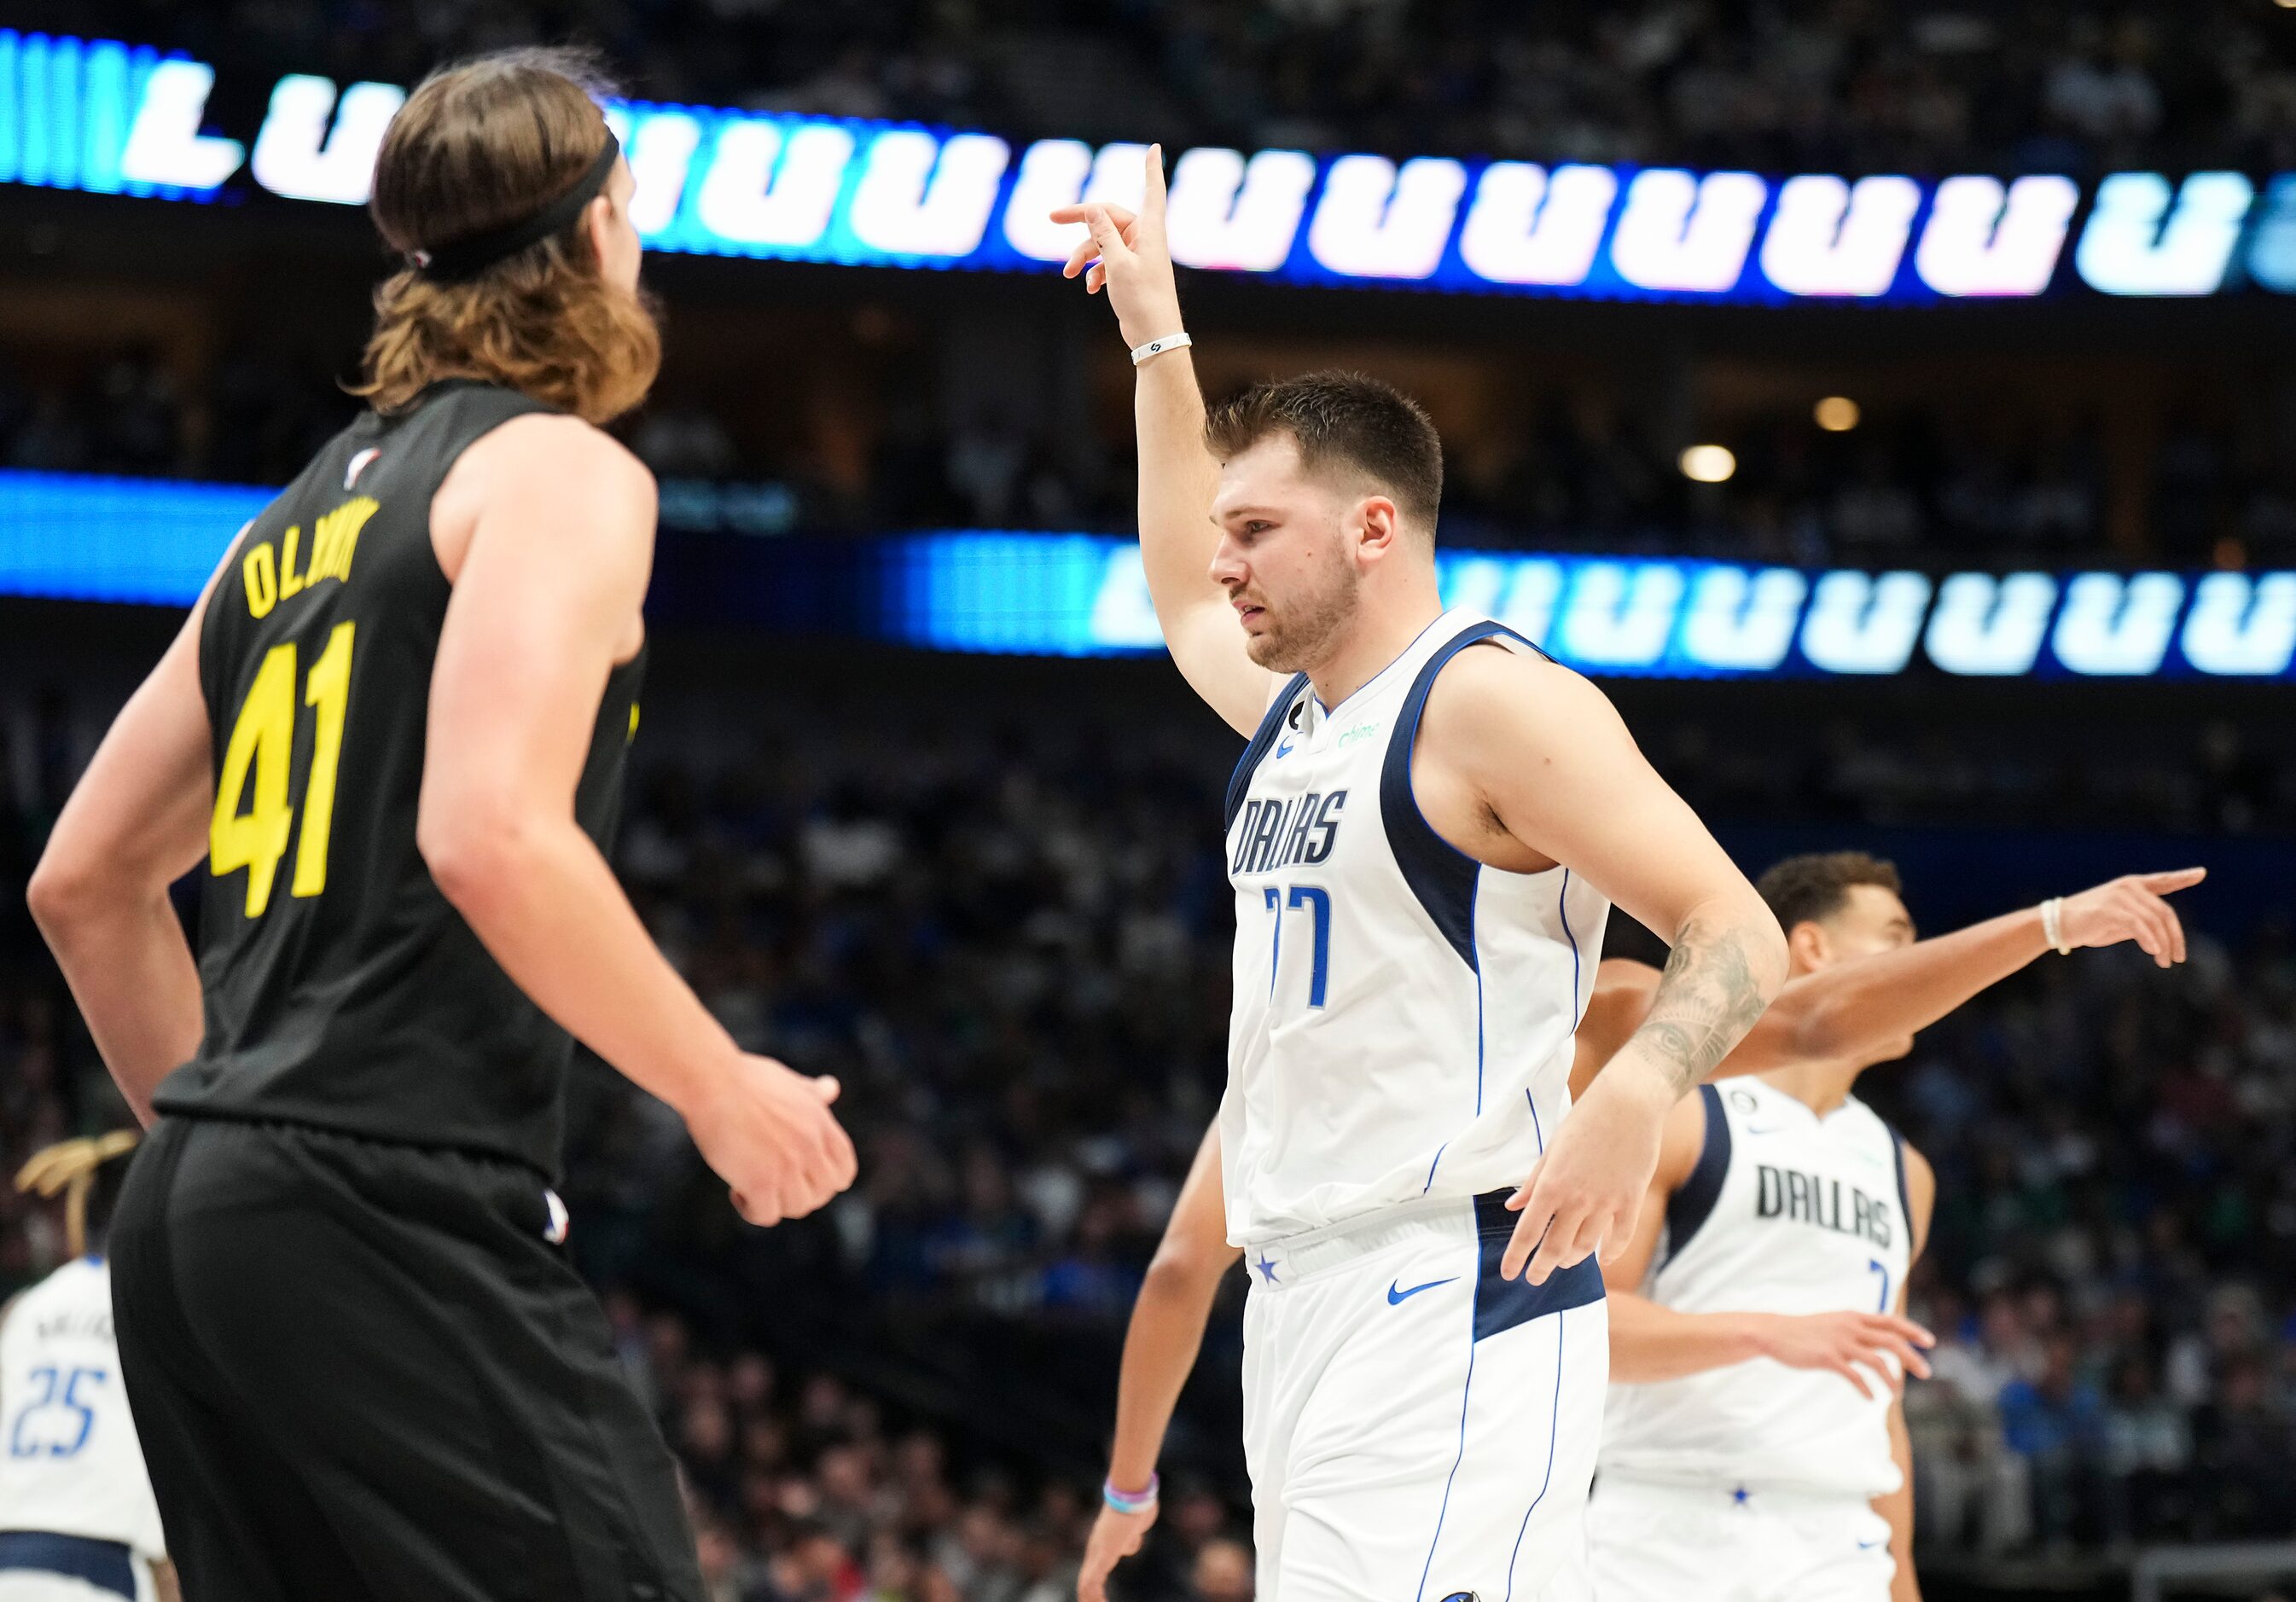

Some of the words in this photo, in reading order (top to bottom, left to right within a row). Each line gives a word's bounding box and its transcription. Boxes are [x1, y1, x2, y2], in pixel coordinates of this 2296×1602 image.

[209, 619, 357, 919] 41
[1263, 883, 1333, 1011] 77
[1755, 1163, 1891, 1250] DALLAS
[11, 1367, 108, 1458] 25
